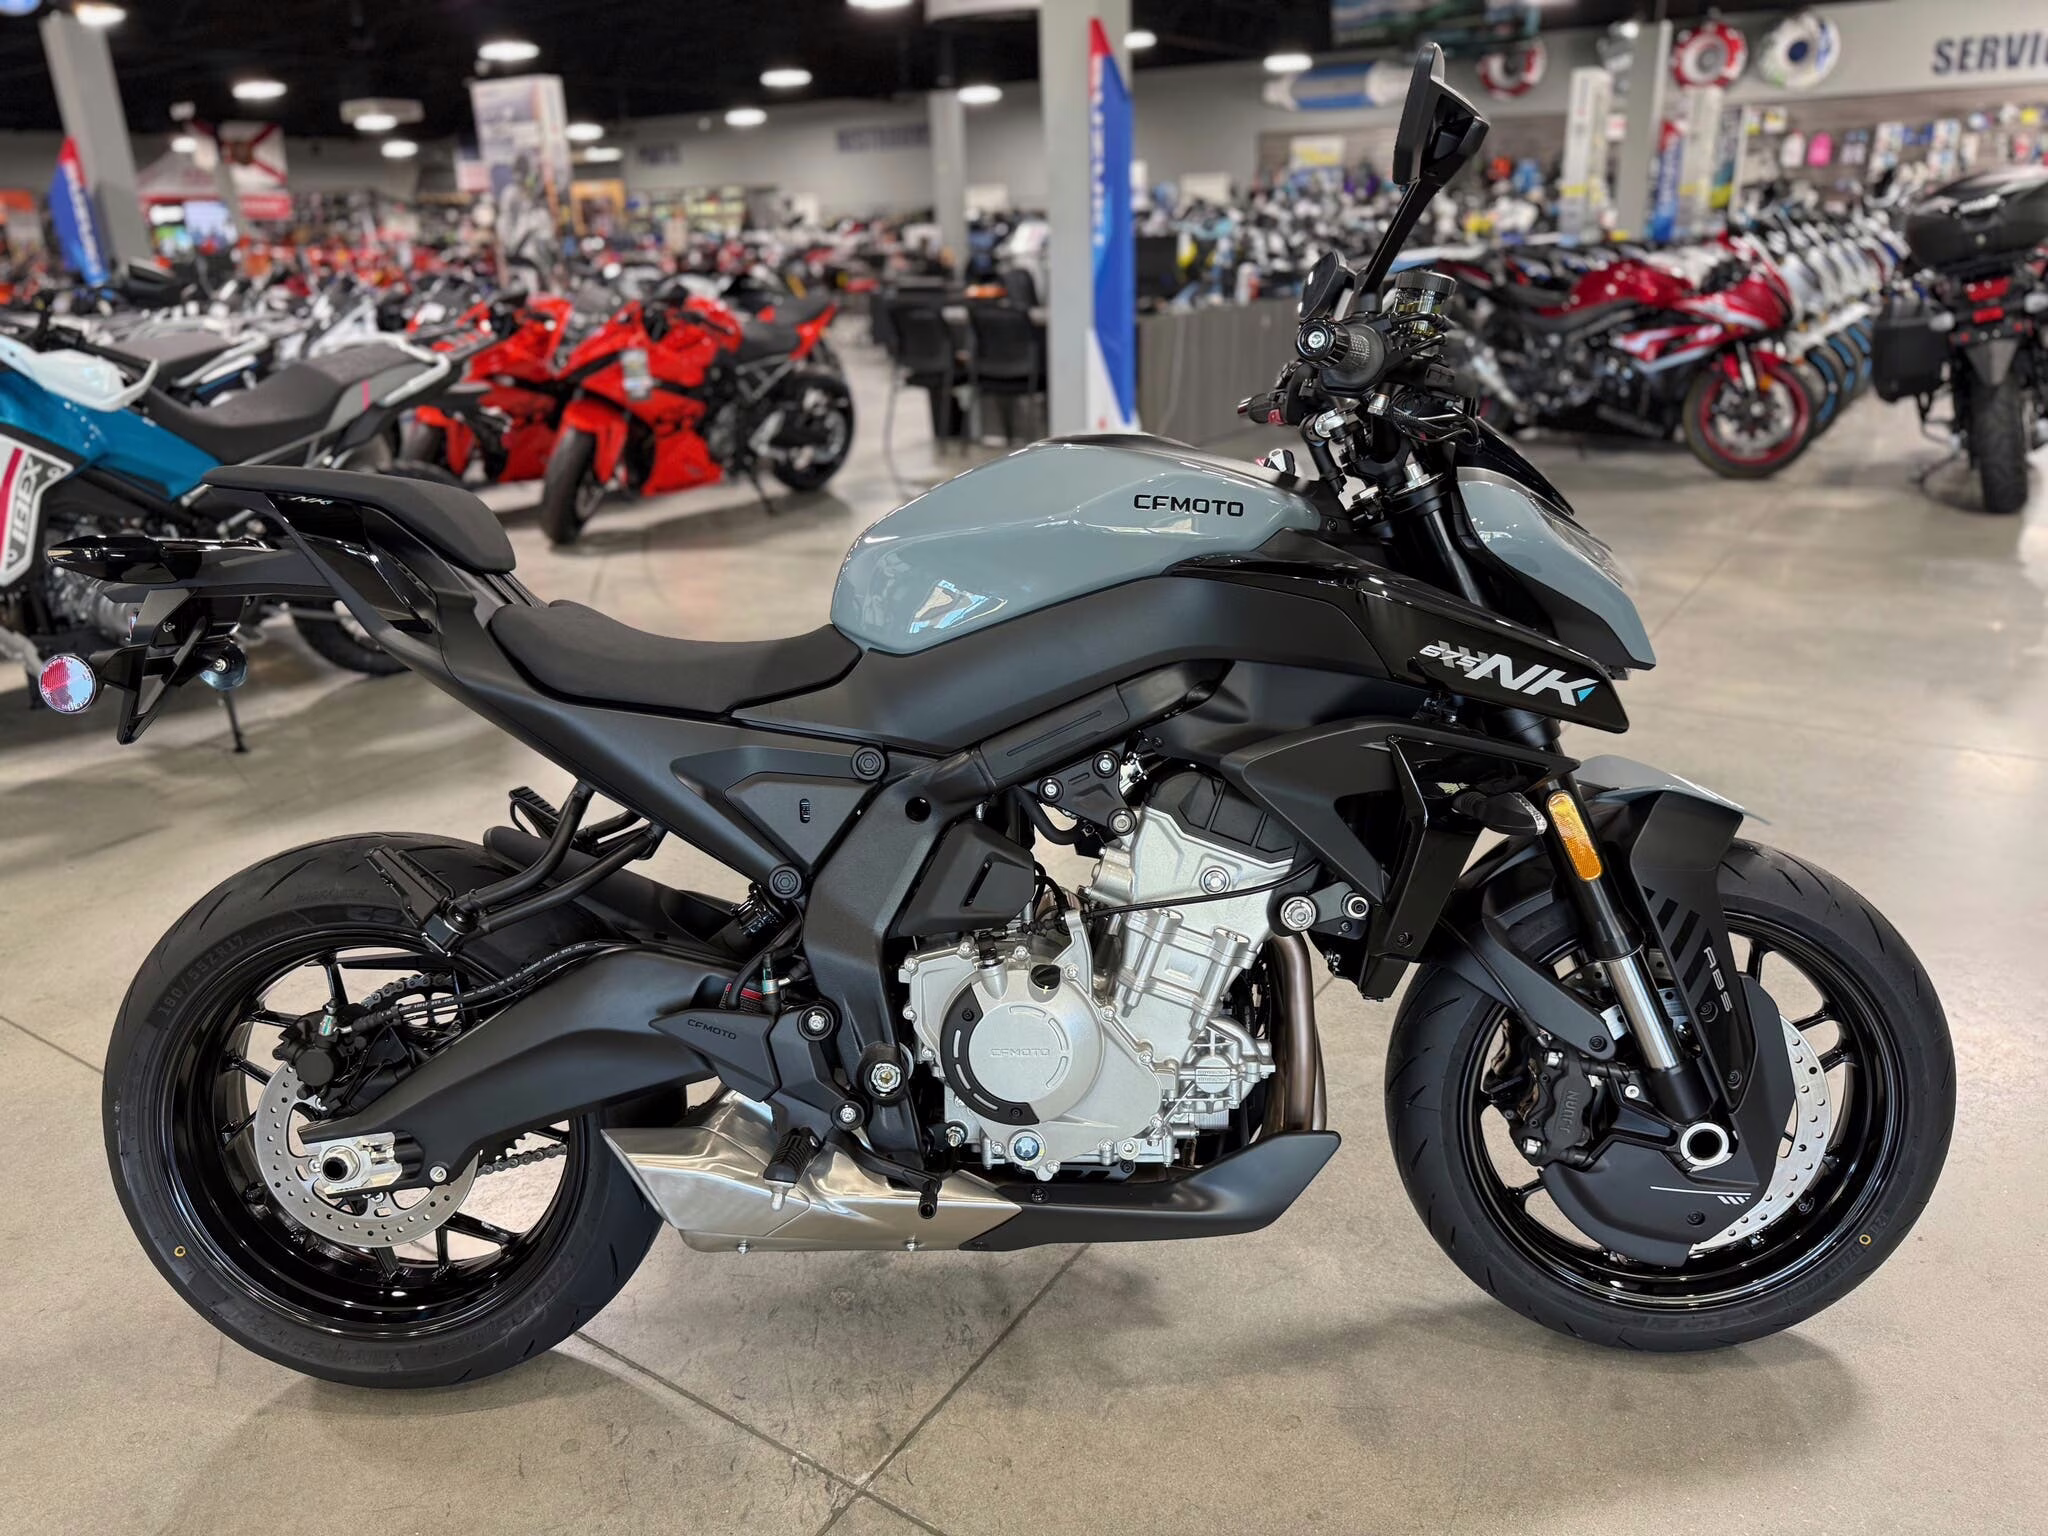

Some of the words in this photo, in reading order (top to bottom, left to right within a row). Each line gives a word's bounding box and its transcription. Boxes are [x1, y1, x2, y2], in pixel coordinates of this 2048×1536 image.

[1931, 31, 2048, 76] SERVI
[1134, 494, 1244, 517] CFMOTO
[1419, 644, 1482, 668] 675
[1464, 653, 1599, 706] NK
[157, 935, 244, 1017] 180/55ZR17
[1703, 946, 1733, 1012] ABS
[687, 1019, 737, 1040] CFMOTO
[991, 1048, 1050, 1056] CFMOTO
